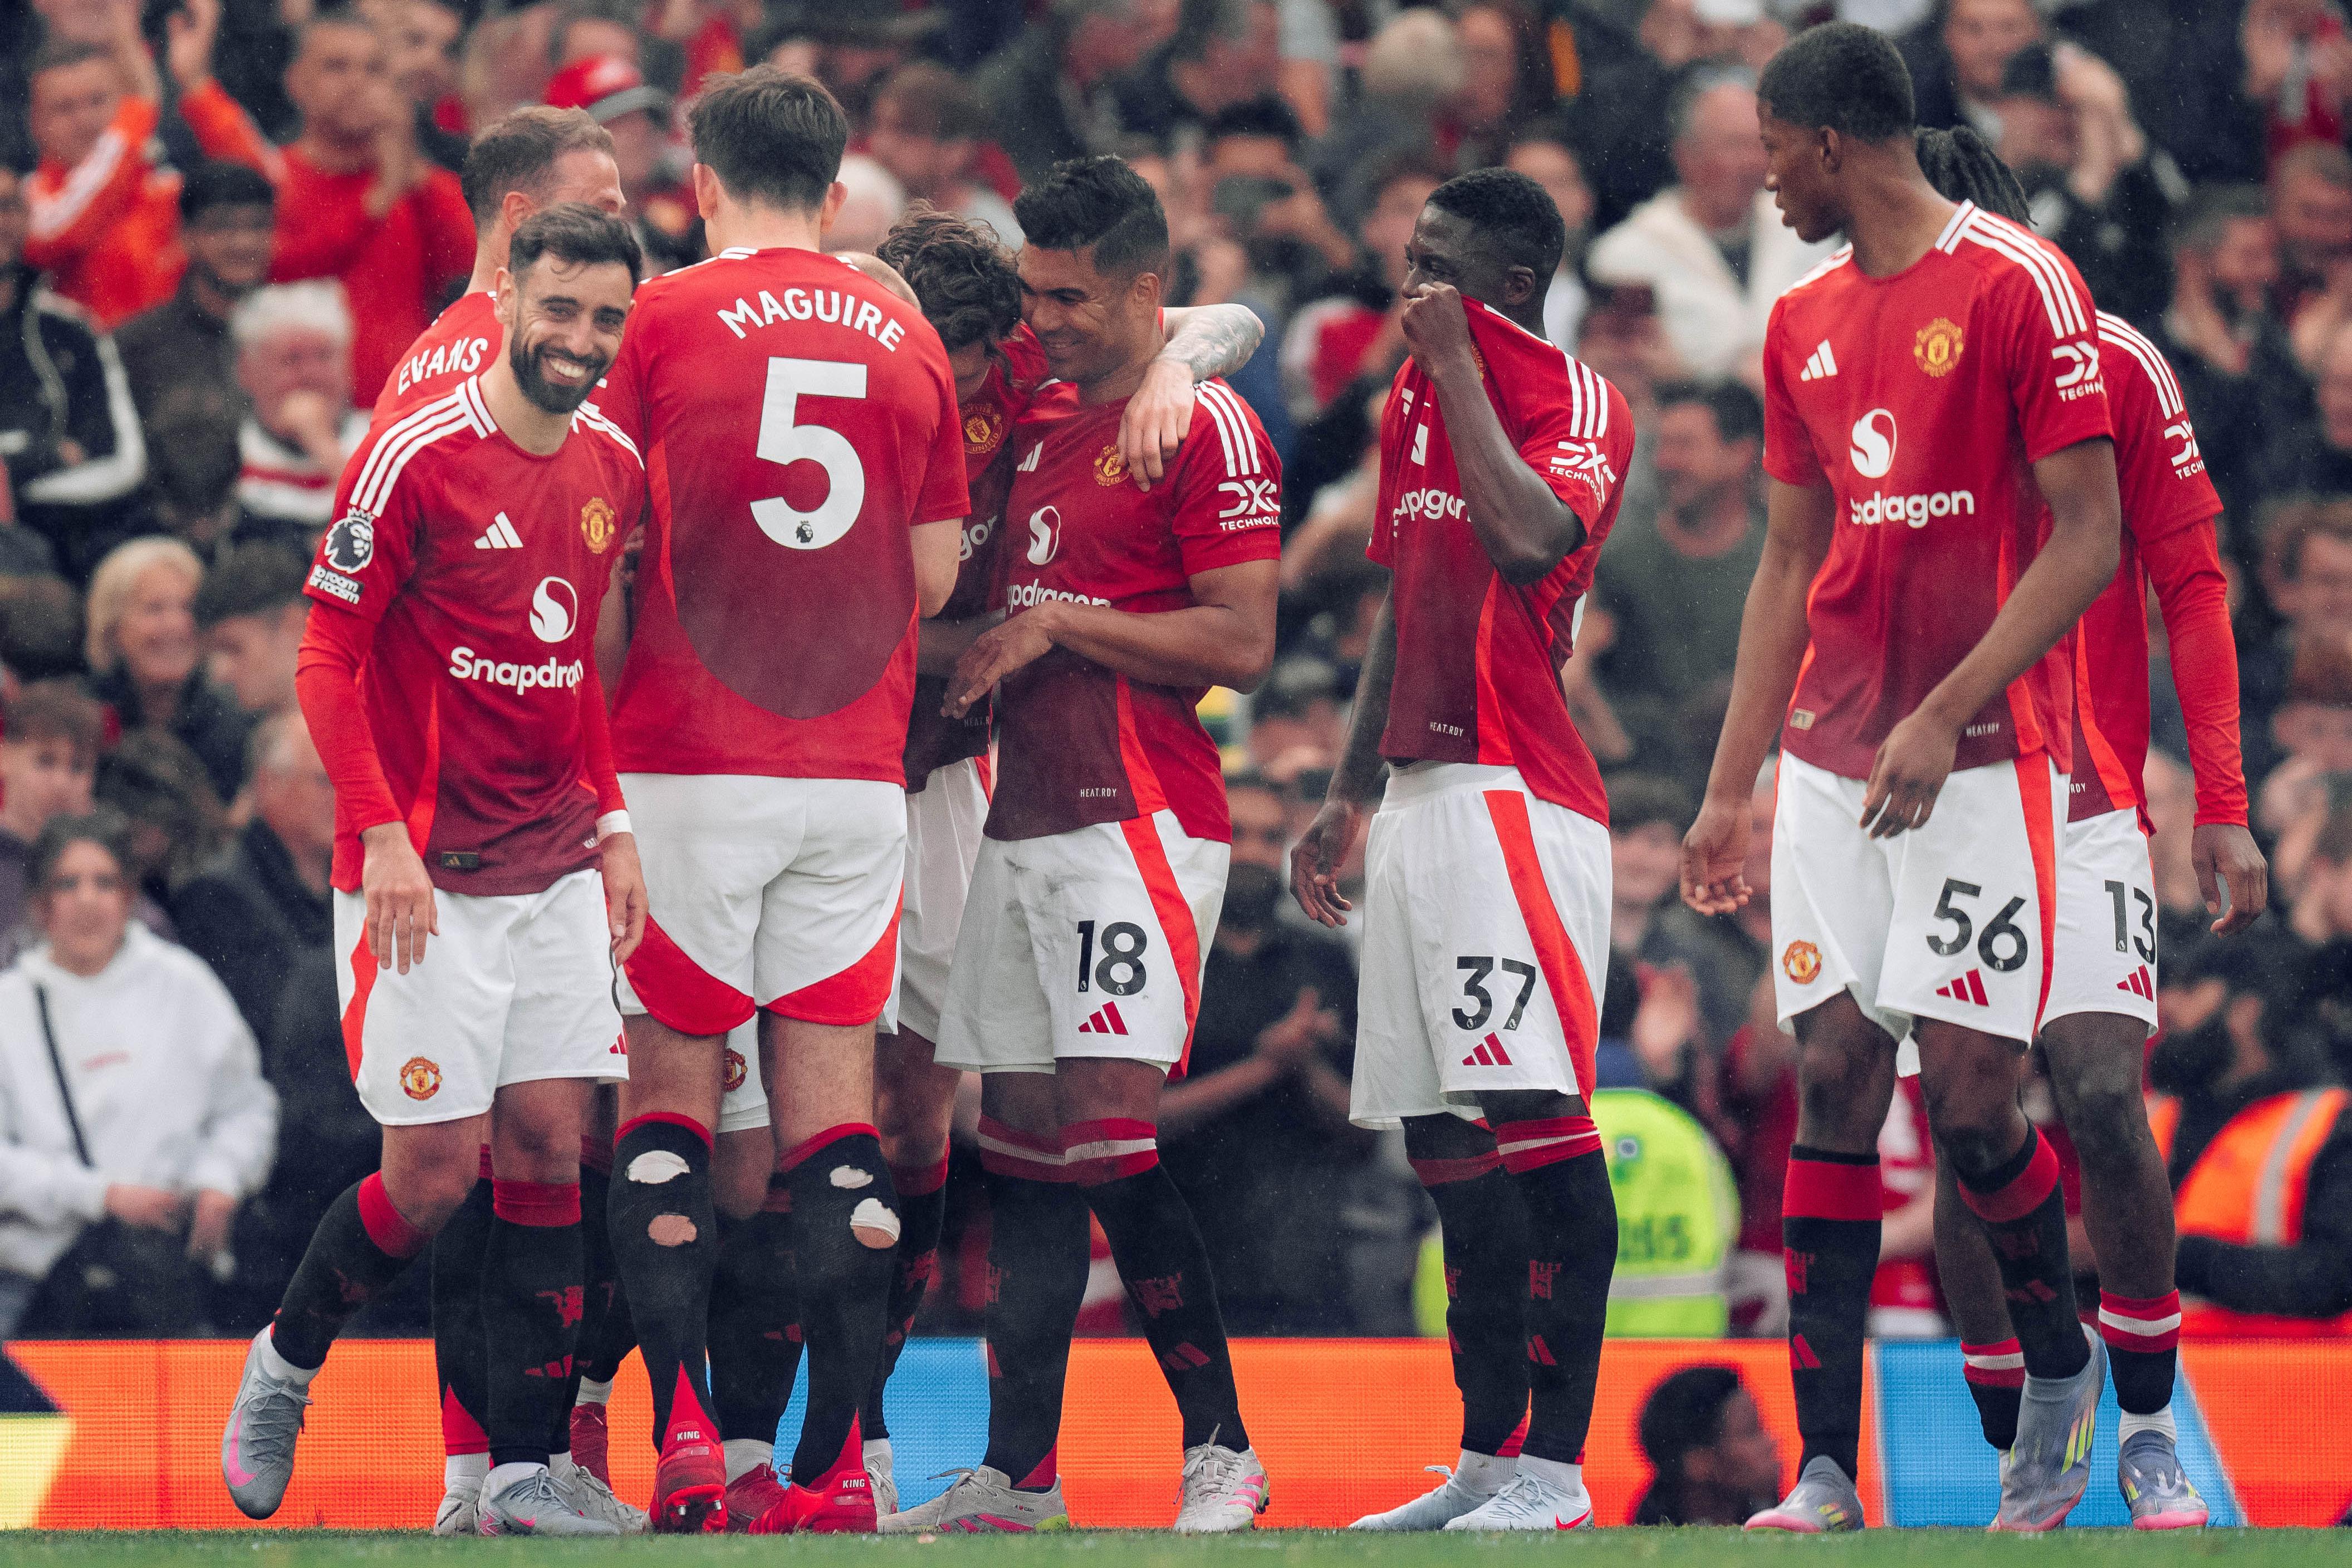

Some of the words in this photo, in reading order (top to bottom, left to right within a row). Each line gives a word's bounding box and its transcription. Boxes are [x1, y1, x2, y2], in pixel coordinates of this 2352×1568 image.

[717, 288, 905, 352] MAGUIRE
[398, 337, 488, 396] EVANS
[750, 356, 867, 550] 5
[1429, 722, 1464, 737] HEAT.RDY
[1080, 787, 1117, 797] HEAT.RDY
[1925, 878, 2028, 973] 56
[2104, 879, 2157, 965] 13
[1076, 920, 1148, 996] 18
[1452, 955, 1536, 1031] 37
[677, 1430, 700, 1441] KING
[842, 1478, 865, 1489] KING
